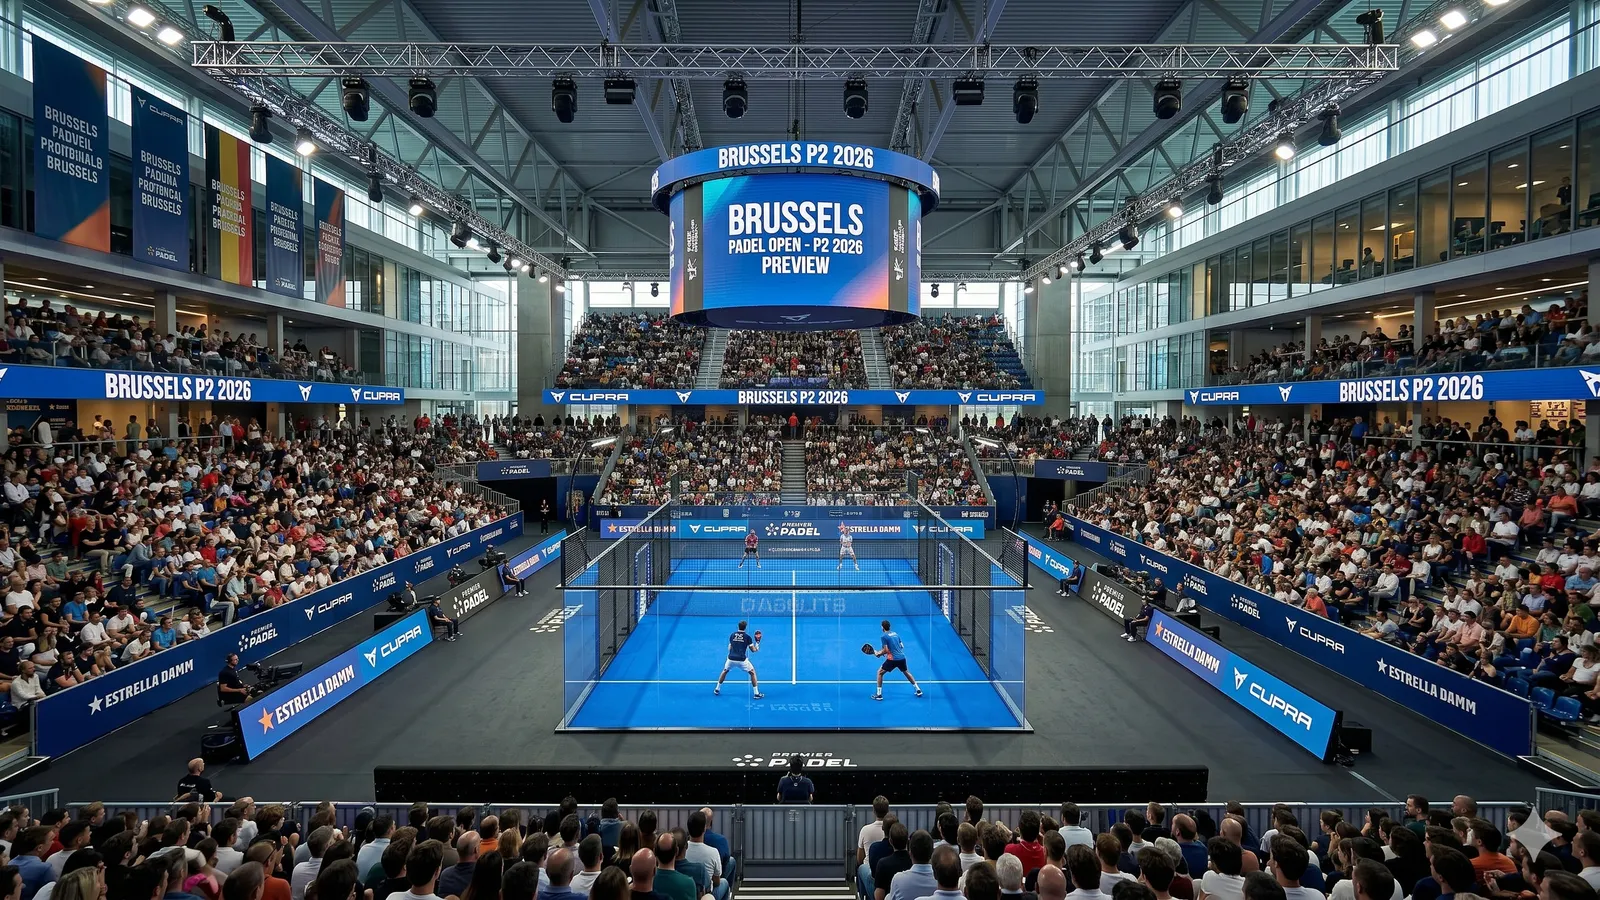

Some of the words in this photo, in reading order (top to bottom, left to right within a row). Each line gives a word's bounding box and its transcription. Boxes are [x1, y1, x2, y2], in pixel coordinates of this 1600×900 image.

[45, 105, 98, 138] BRUSSELS
[141, 150, 181, 176] BRUSSELS
[718, 143, 802, 169] BRUSSELS
[806, 143, 828, 164] P2
[833, 145, 874, 169] 2026
[47, 155, 98, 184] BRUSSELS
[211, 179, 245, 201] BRUSSELS
[141, 193, 182, 216] BRUSSELS
[728, 201, 864, 236] BRUSSELS
[155, 250, 178, 262] PADEL
[728, 238, 766, 255] PADEL
[768, 237, 801, 252] OPEN
[813, 237, 829, 253] P2
[832, 238, 863, 254] 2026
[762, 256, 830, 274] PREVIEW
[105, 372, 192, 400] BRUSSELS
[195, 378, 214, 400] P2
[217, 379, 251, 401] 2026
[363, 391, 401, 401] CUPRA
[569, 393, 629, 401] CUPRA
[738, 390, 798, 404] BRUSSELS
[800, 391, 815, 404] P2
[818, 391, 848, 404] 2026
[1201, 391, 1239, 402] CUPRA
[1339, 378, 1410, 402] BRUSSELS
[1412, 377, 1433, 401] P2
[1437, 374, 1484, 401] 2026
[976, 394, 1036, 402] CUPRA
[780, 527, 821, 536] PADEL
[847, 525, 879, 533] STRELLA
[879, 525, 901, 533] DAMM
[1189, 580, 1208, 596] PADEL
[317, 592, 353, 614] CUPRA
[463, 588, 489, 613] PADEL
[1099, 592, 1125, 619] PADEL
[1238, 602, 1261, 619] PADEL
[249, 628, 278, 648] PADEL
[250, 622, 273, 636] PREMIER
[1300, 626, 1345, 654] CUPRA
[380, 625, 422, 658] CUPRA
[1162, 628, 1194, 657] ESTRELLA
[1194, 647, 1221, 674] DAMM
[105, 674, 160, 708] ESTRELLA
[161, 658, 194, 684] DAMM
[1388, 664, 1438, 698] ESTRELLA
[1439, 686, 1477, 716] DAMM
[275, 677, 325, 725] ESTRELLA
[325, 664, 355, 694] DAMM
[1249, 682, 1313, 731] CUPRA
[768, 758, 858, 768] PDEL
